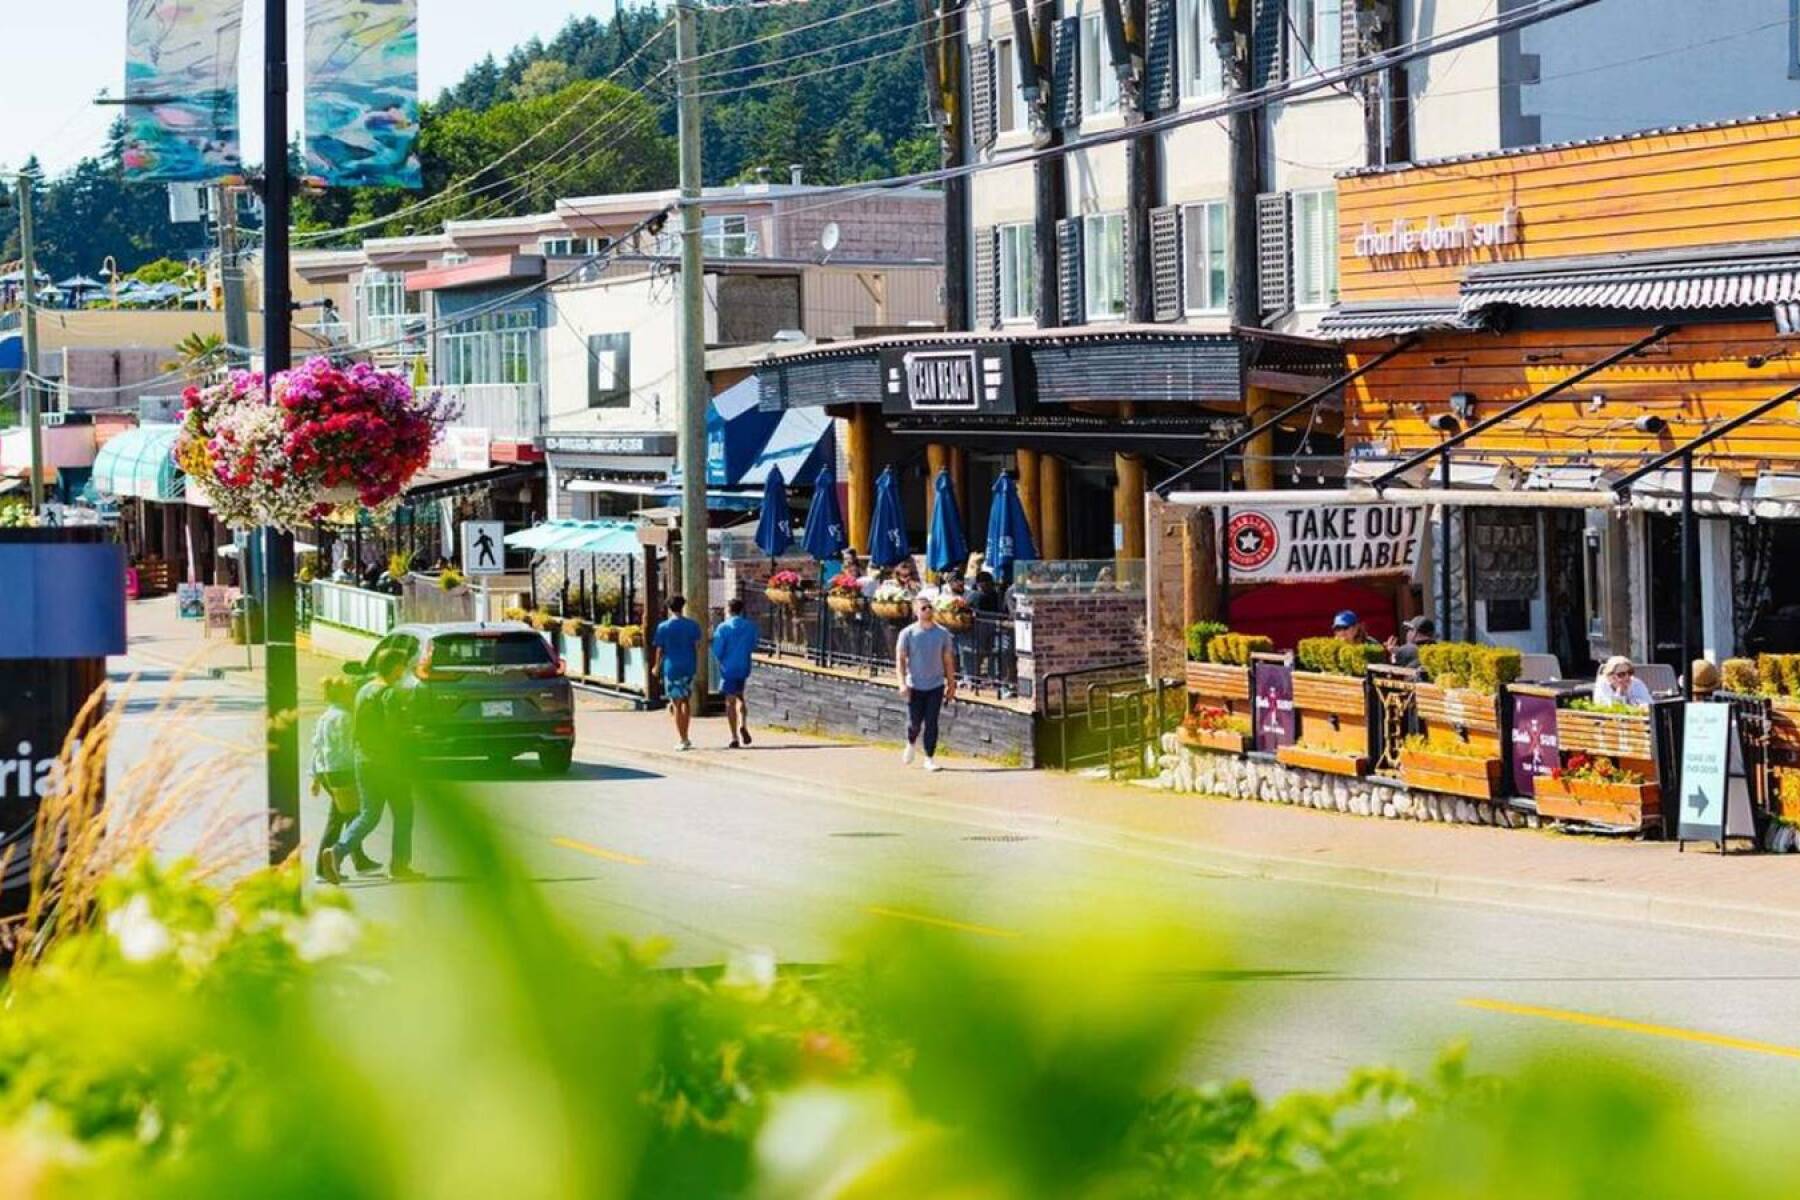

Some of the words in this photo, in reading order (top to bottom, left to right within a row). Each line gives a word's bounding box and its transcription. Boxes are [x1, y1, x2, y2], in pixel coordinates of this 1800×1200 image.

[1355, 218, 1414, 256] charlie
[1472, 207, 1518, 246] surf
[907, 360, 936, 400] OCEAN
[938, 360, 969, 400] BEACH
[1286, 507, 1356, 541] TAKE
[1365, 506, 1421, 539] OUT
[1286, 540, 1416, 572] AVAILABLE
